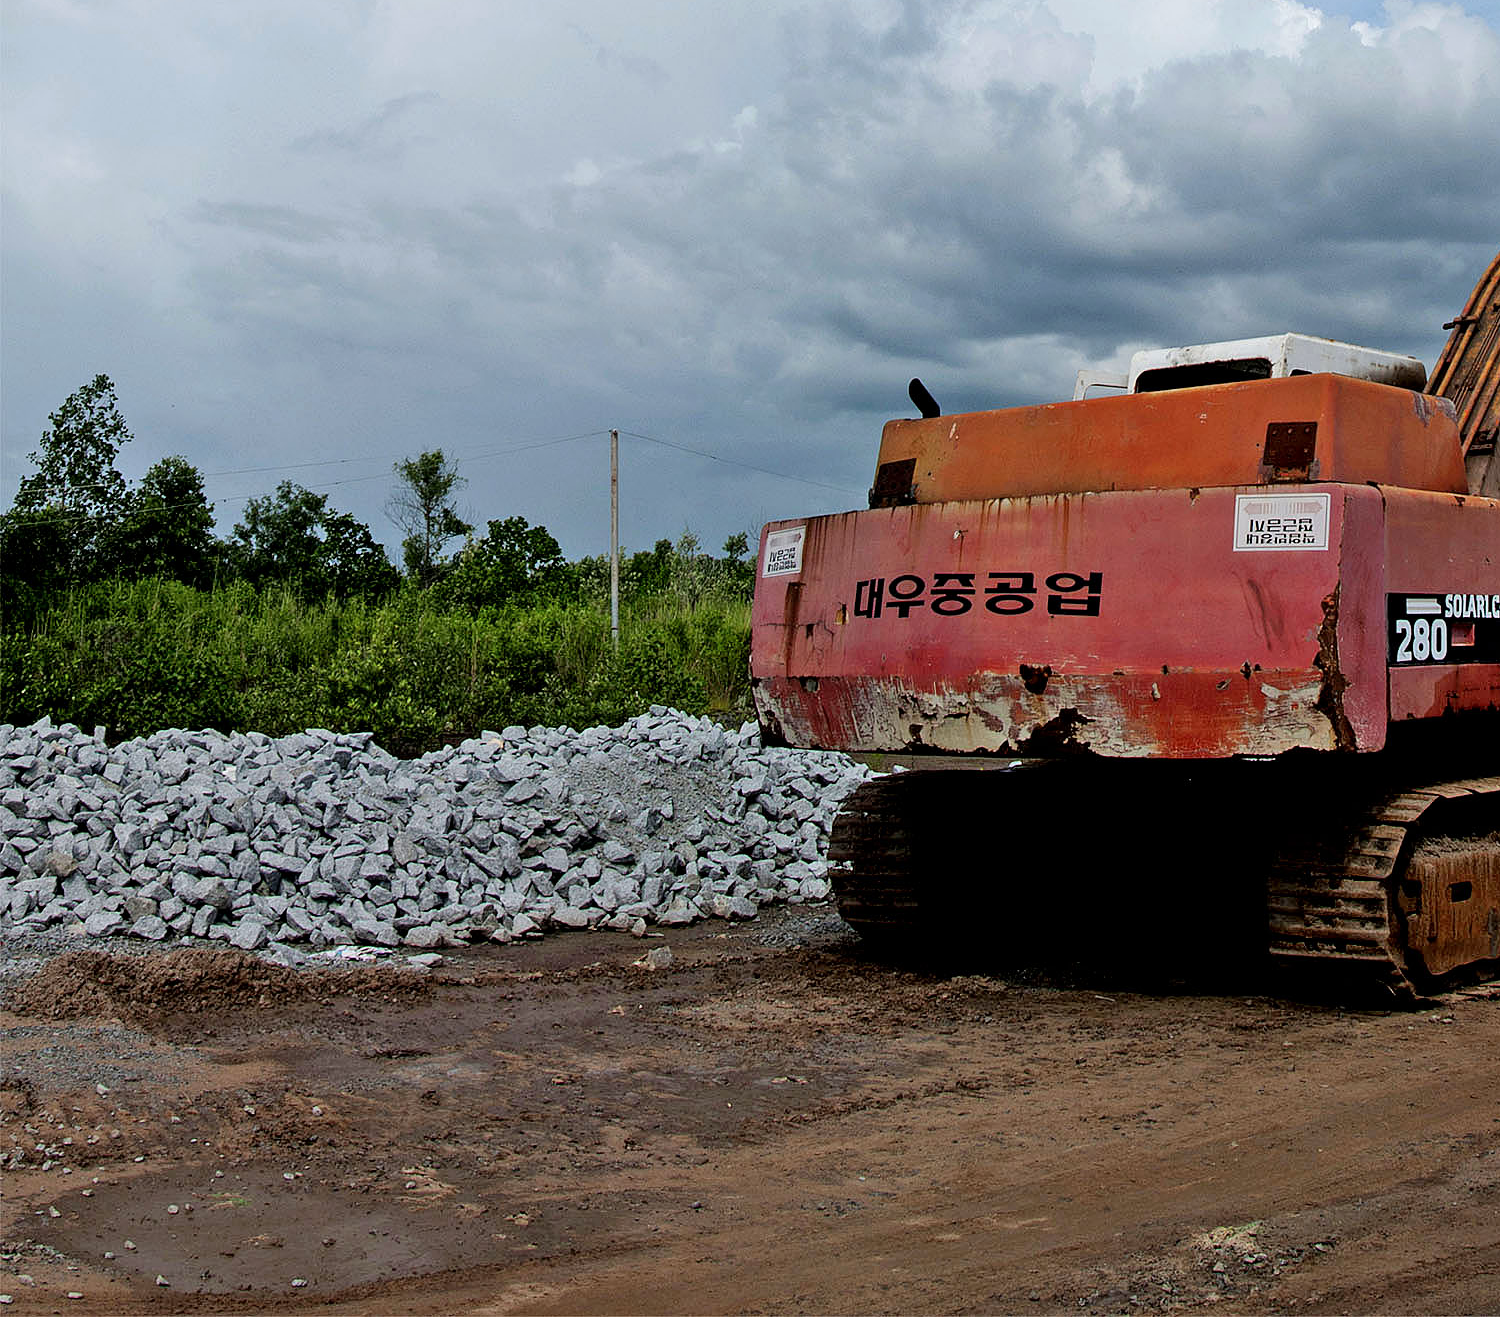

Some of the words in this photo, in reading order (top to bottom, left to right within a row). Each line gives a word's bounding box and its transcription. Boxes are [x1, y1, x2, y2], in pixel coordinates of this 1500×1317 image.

[1249, 518, 1313, 532] 접근금지
[853, 572, 1103, 619] 대우중공업
[1395, 618, 1448, 662] 280
